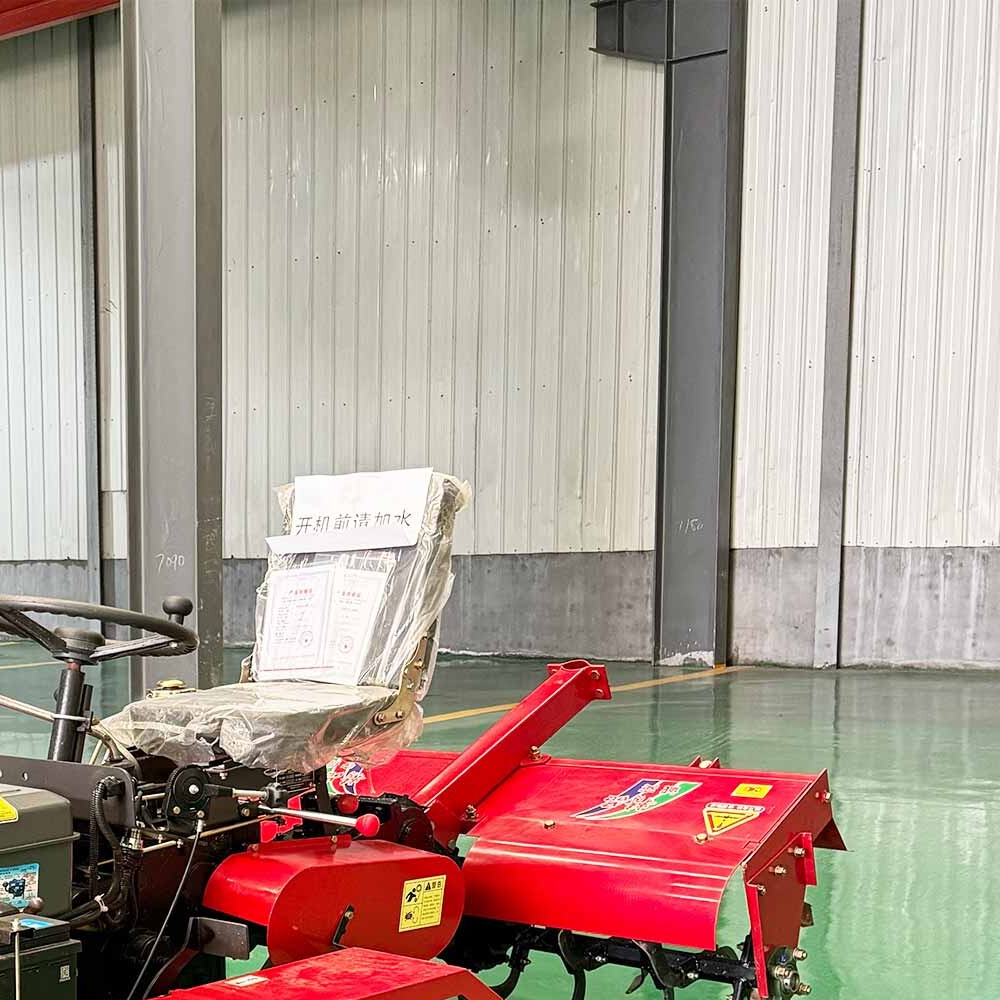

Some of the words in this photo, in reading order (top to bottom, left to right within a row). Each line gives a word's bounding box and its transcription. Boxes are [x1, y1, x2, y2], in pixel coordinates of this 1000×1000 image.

[296, 509, 412, 536] 开机前请加水
[154, 553, 185, 574] 7090
